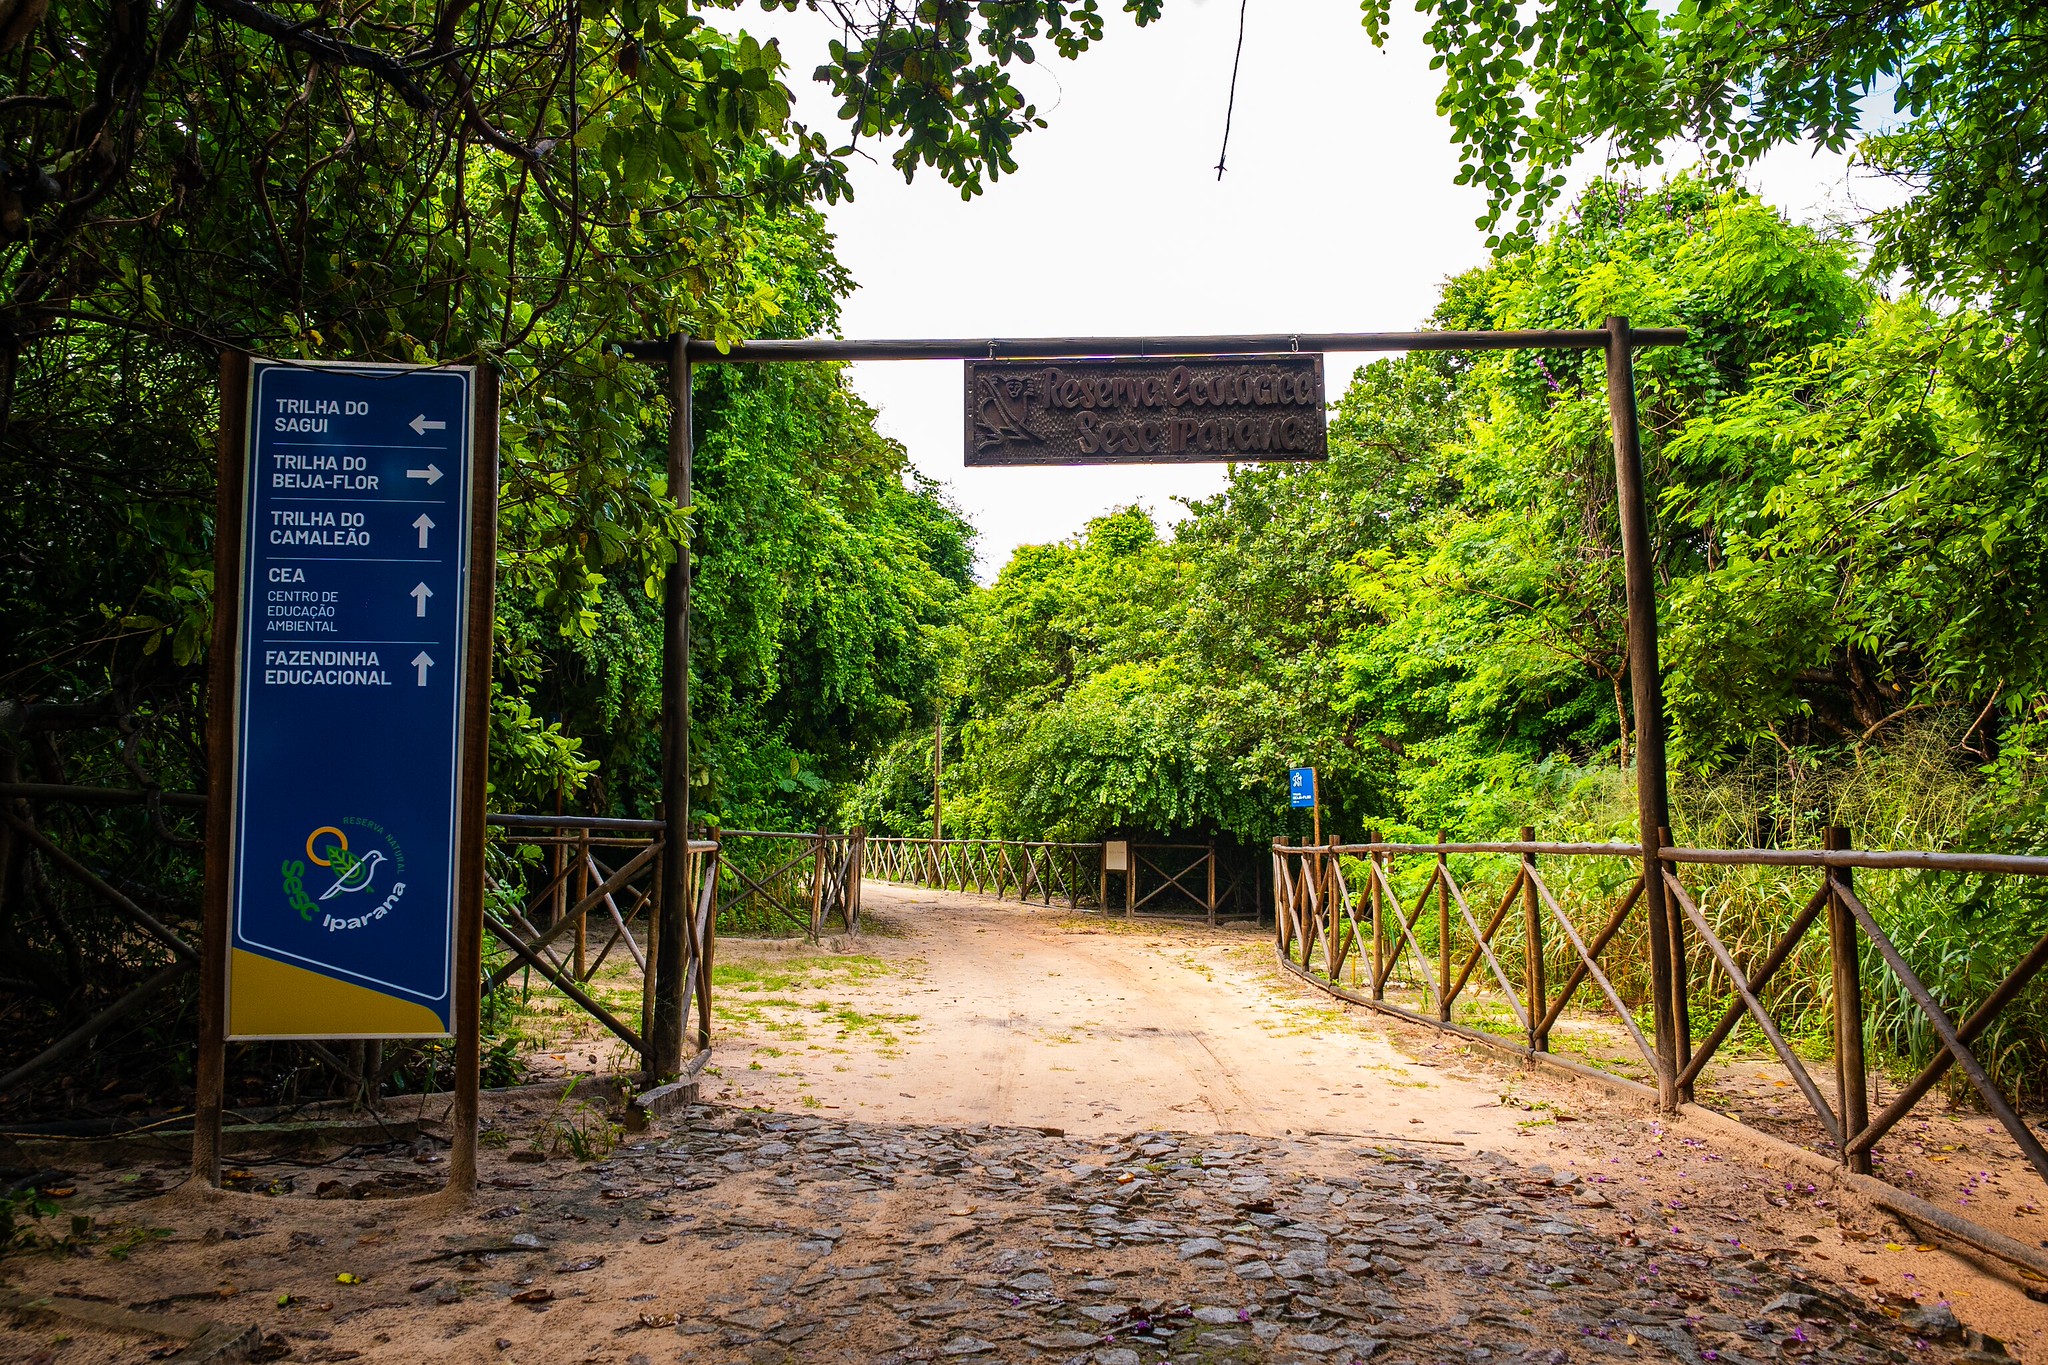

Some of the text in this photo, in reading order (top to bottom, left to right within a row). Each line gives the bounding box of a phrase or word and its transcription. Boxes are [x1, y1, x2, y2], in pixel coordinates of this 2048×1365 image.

[1042, 364, 1315, 408] Reserva Ecológica
[276, 399, 369, 415] TRILHA DO
[275, 417, 328, 432] SAGUI
[1075, 410, 1160, 454] Sesc
[273, 455, 367, 471] TRILHA DO
[272, 474, 379, 490] BEIJA-FLOR
[271, 511, 365, 527] TRILHA DO
[270, 528, 370, 546] CAMALEÃO
[268, 568, 305, 583] CEA
[267, 591, 338, 602] CENTRO DE
[267, 604, 335, 619] EDUCAÇÃO
[266, 620, 338, 632] AMBIENTAL
[265, 651, 379, 666] FAZENDINHA
[265, 670, 392, 685] EDUCACIONAL
[343, 817, 405, 874] RESERVA NATURAL
[323, 882, 407, 932] Iparana
